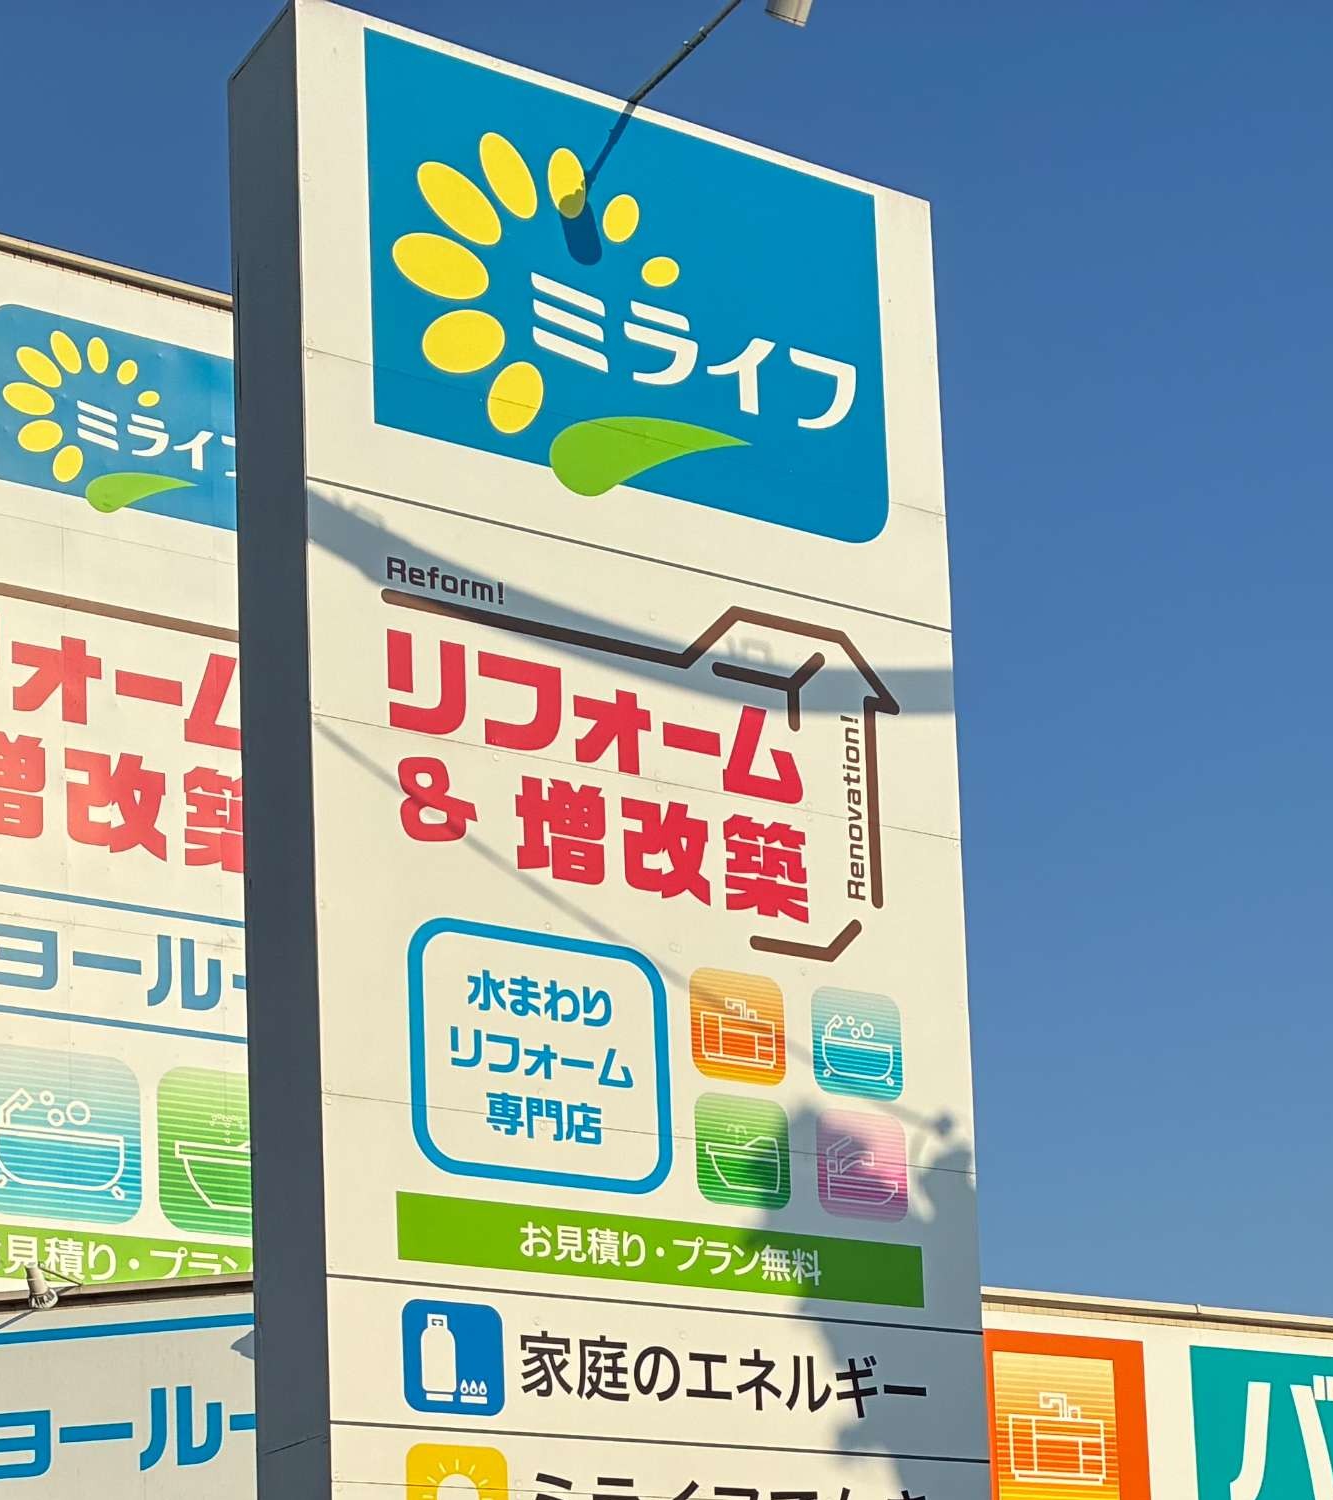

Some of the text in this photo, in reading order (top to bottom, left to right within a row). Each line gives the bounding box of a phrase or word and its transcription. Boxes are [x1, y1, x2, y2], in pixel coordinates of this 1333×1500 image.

[530, 271, 857, 430] ミライフ
[386, 557, 505, 604] Reform!
[386, 627, 805, 805] リフォーム
[398, 757, 809, 924] & 増改築
[843, 714, 867, 901] Renovation!
[466, 969, 612, 1028] 水まわり
[449, 1026, 634, 1090] リフォーム
[486, 1092, 603, 1146] 専門店
[518, 1220, 823, 1287] お見積り・プラン無料
[518, 1330, 928, 1420] 家庭のエネルギー
